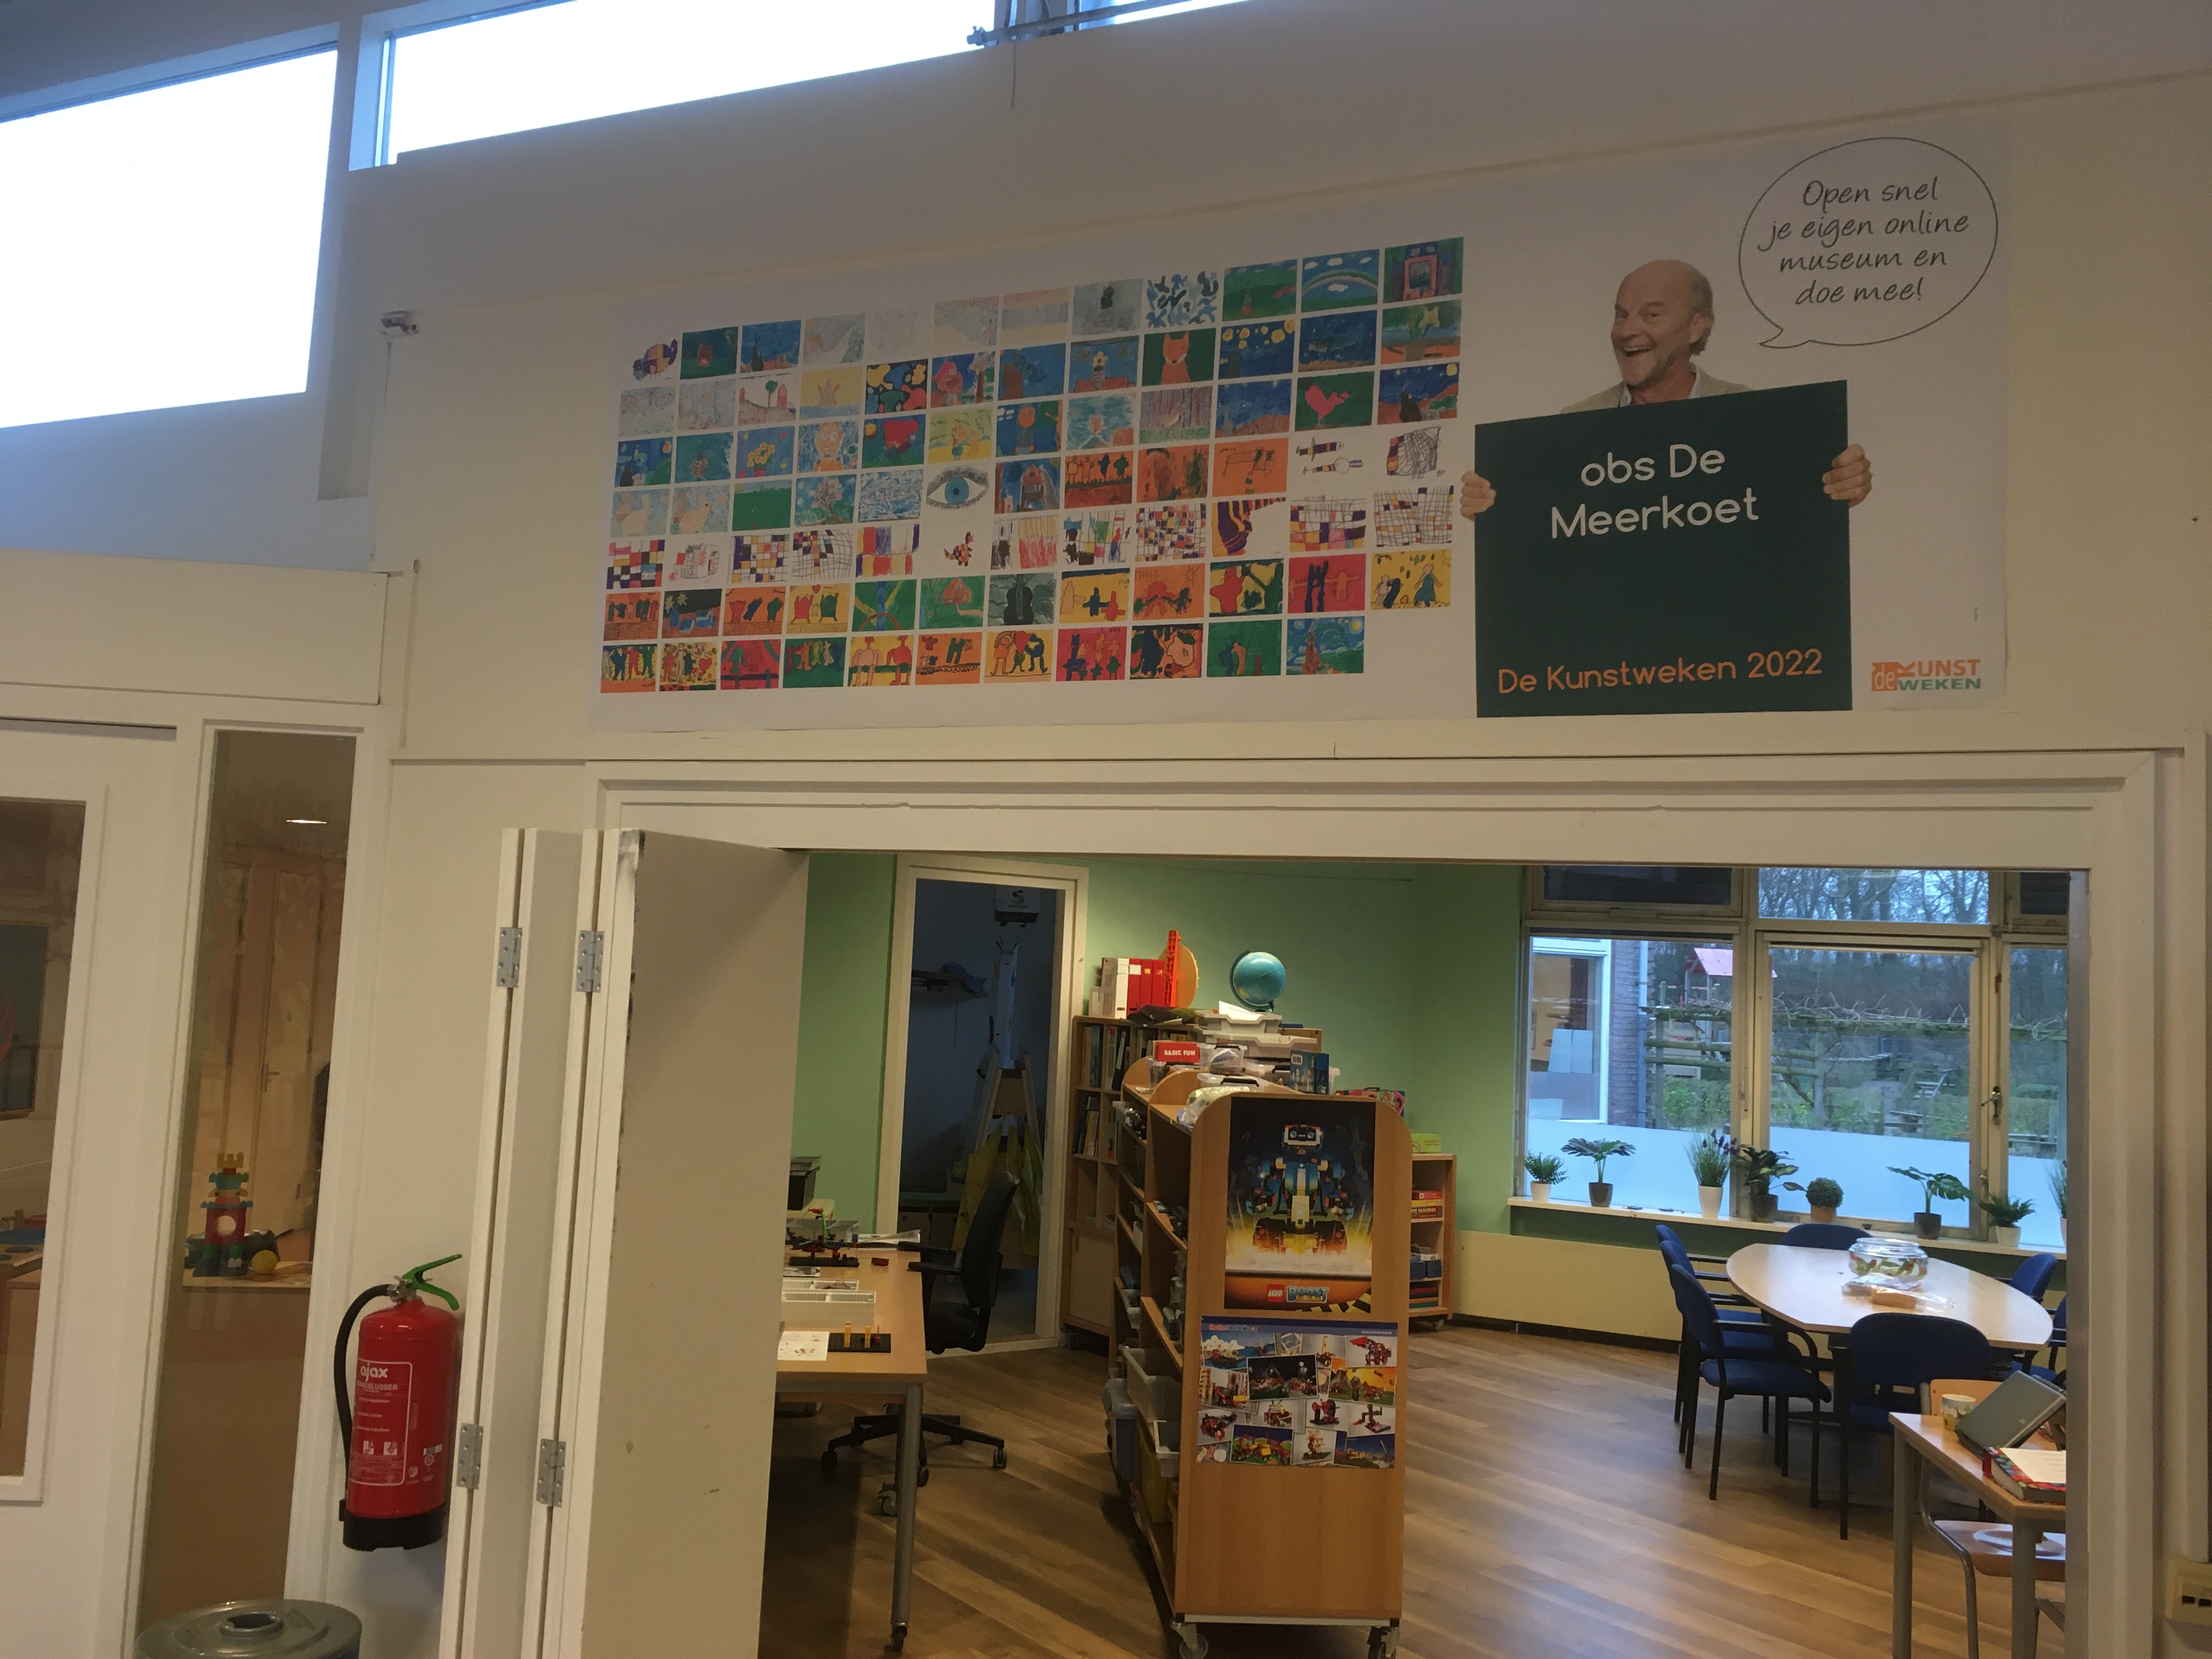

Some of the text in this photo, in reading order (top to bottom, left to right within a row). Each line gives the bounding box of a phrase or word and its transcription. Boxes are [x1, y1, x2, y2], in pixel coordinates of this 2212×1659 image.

[1802, 176, 1938, 213] Open snel
[1757, 210, 1970, 252] je eigen online
[1780, 249, 1948, 272] museum en
[1795, 276, 1923, 305] doe mee!
[1581, 443, 1725, 487] obs De
[1551, 487, 1759, 539] Meerkoet
[1498, 648, 1822, 694] De Kunstweken 2022
[1898, 678, 1981, 691] WEKEN
[360, 1362, 388, 1382] ajax
